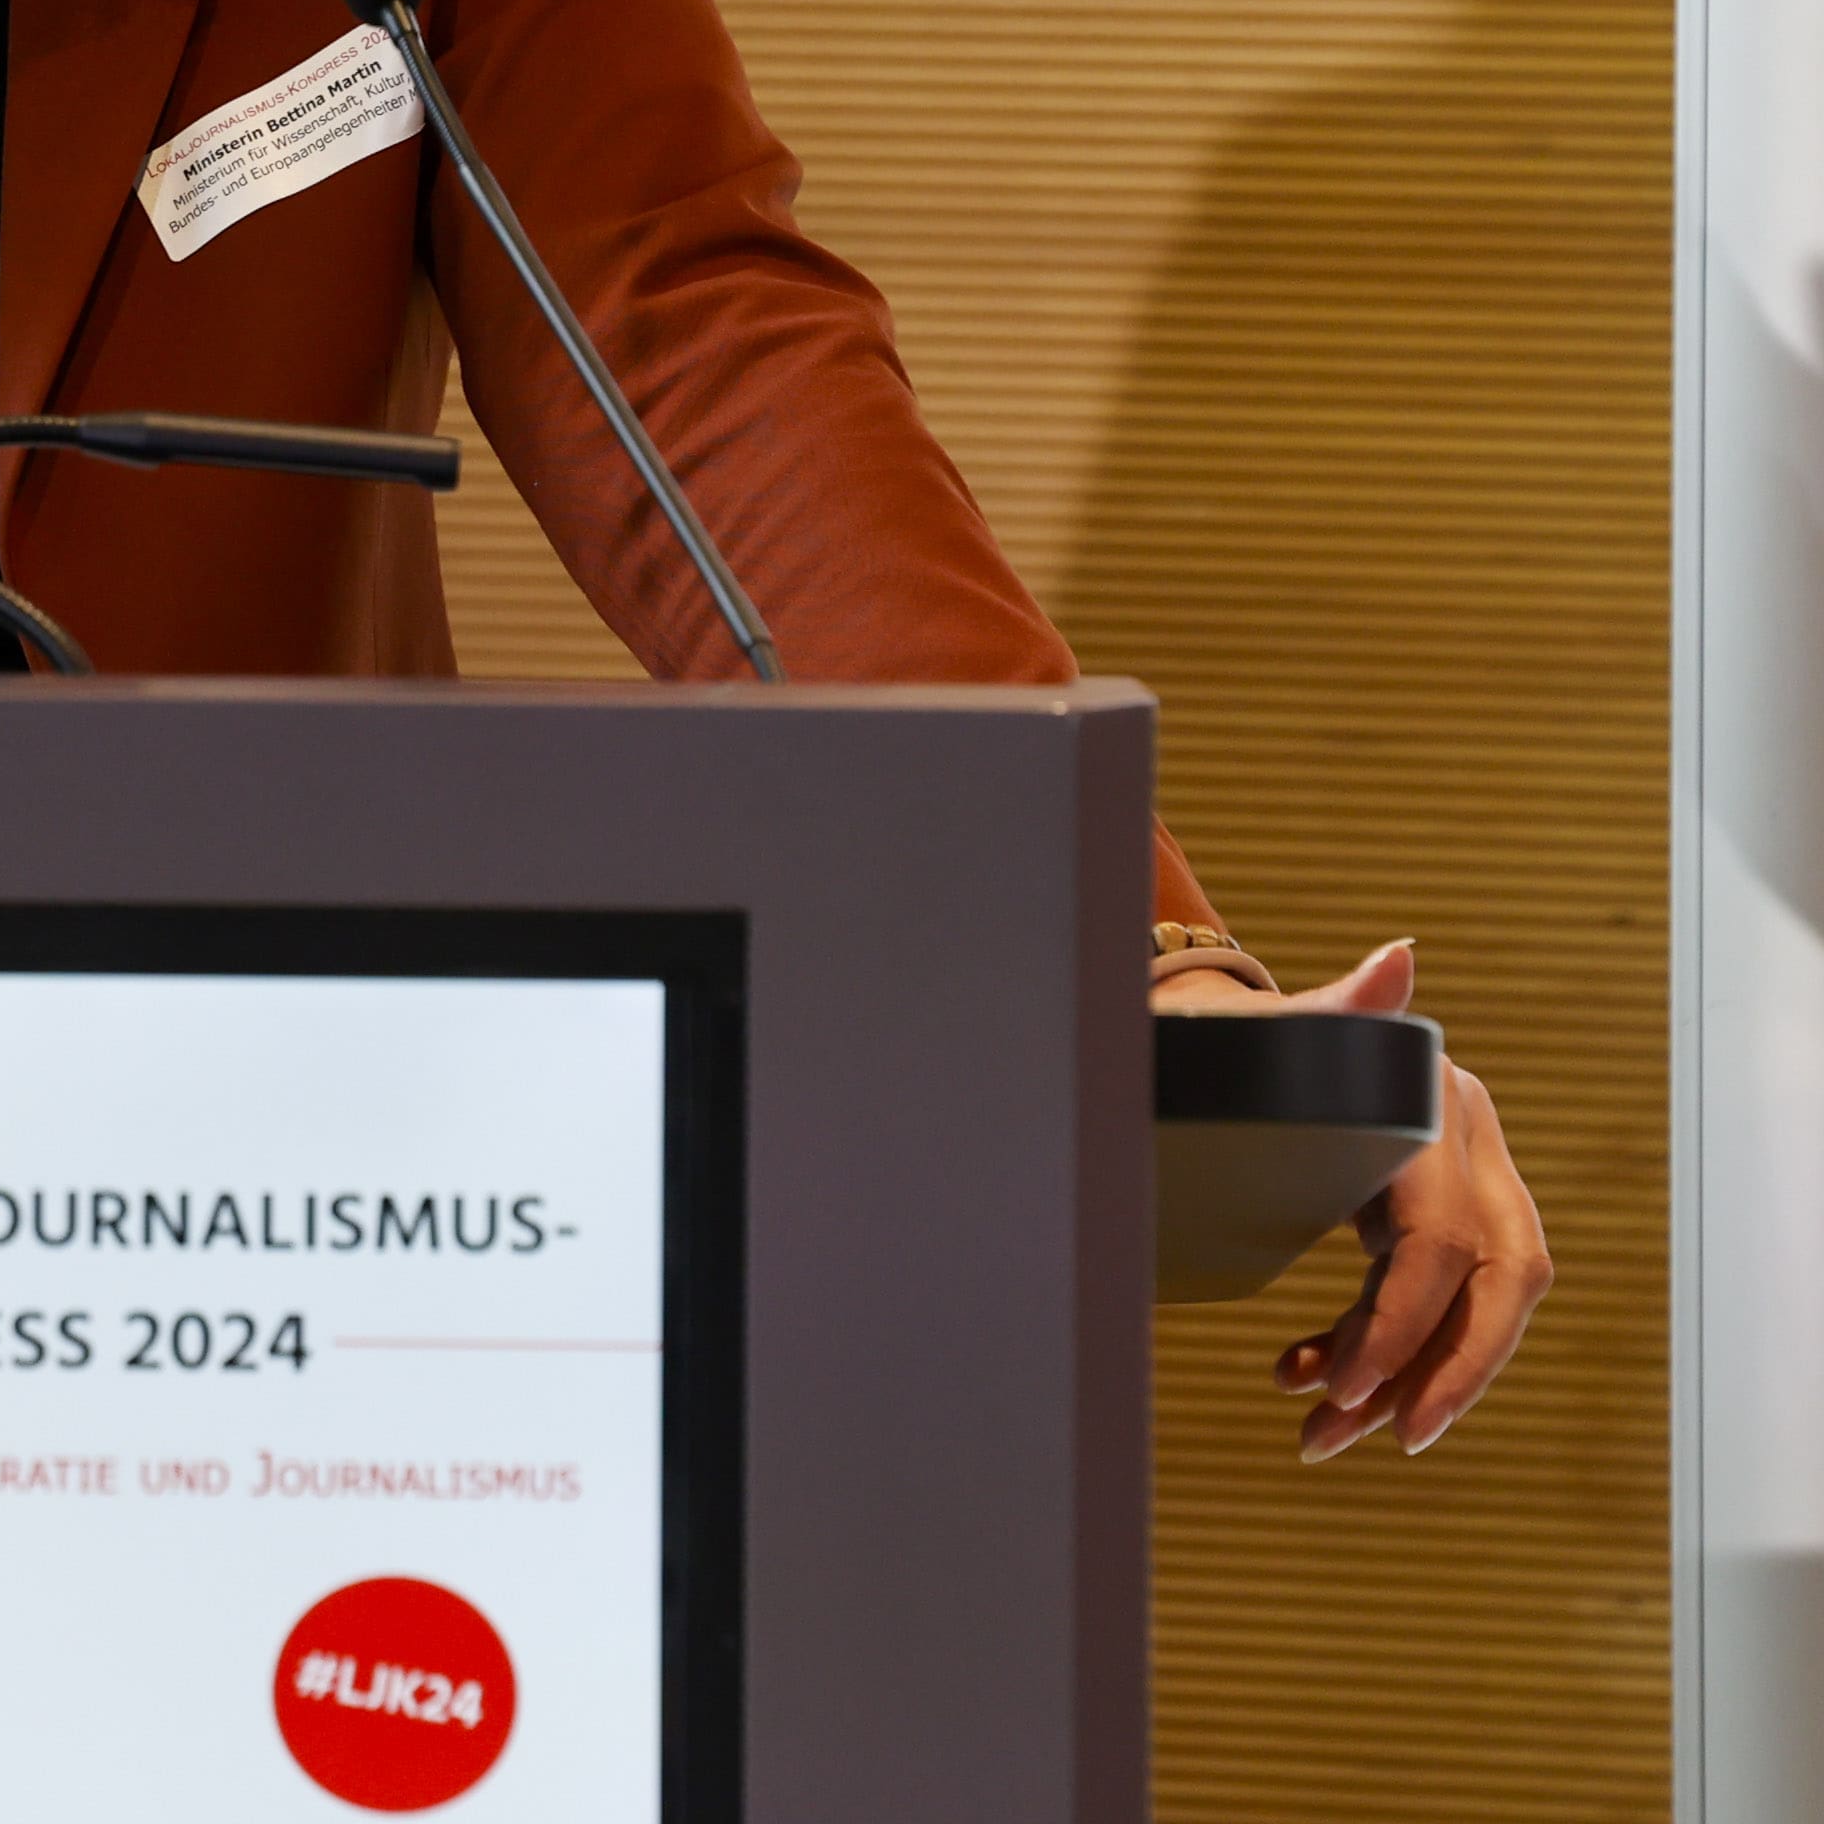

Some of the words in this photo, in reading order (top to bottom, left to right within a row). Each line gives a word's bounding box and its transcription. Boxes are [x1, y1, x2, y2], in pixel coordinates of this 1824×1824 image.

[360, 26, 391, 51] 202
[168, 192, 220, 234] Bundes-
[222, 172, 249, 197] und
[251, 94, 407, 182] Europaangelegenheiten
[172, 155, 246, 211] Ministerium
[248, 143, 269, 161] für
[271, 94, 363, 151] Wissenschaft,
[364, 72, 411, 99] Kultur,
[182, 127, 264, 182] Ministerin
[266, 93, 326, 134] Bettina
[327, 60, 382, 98] Martin
[124, 1311, 310, 1372] 2024
[294, 1650, 484, 1729] #LJK24
